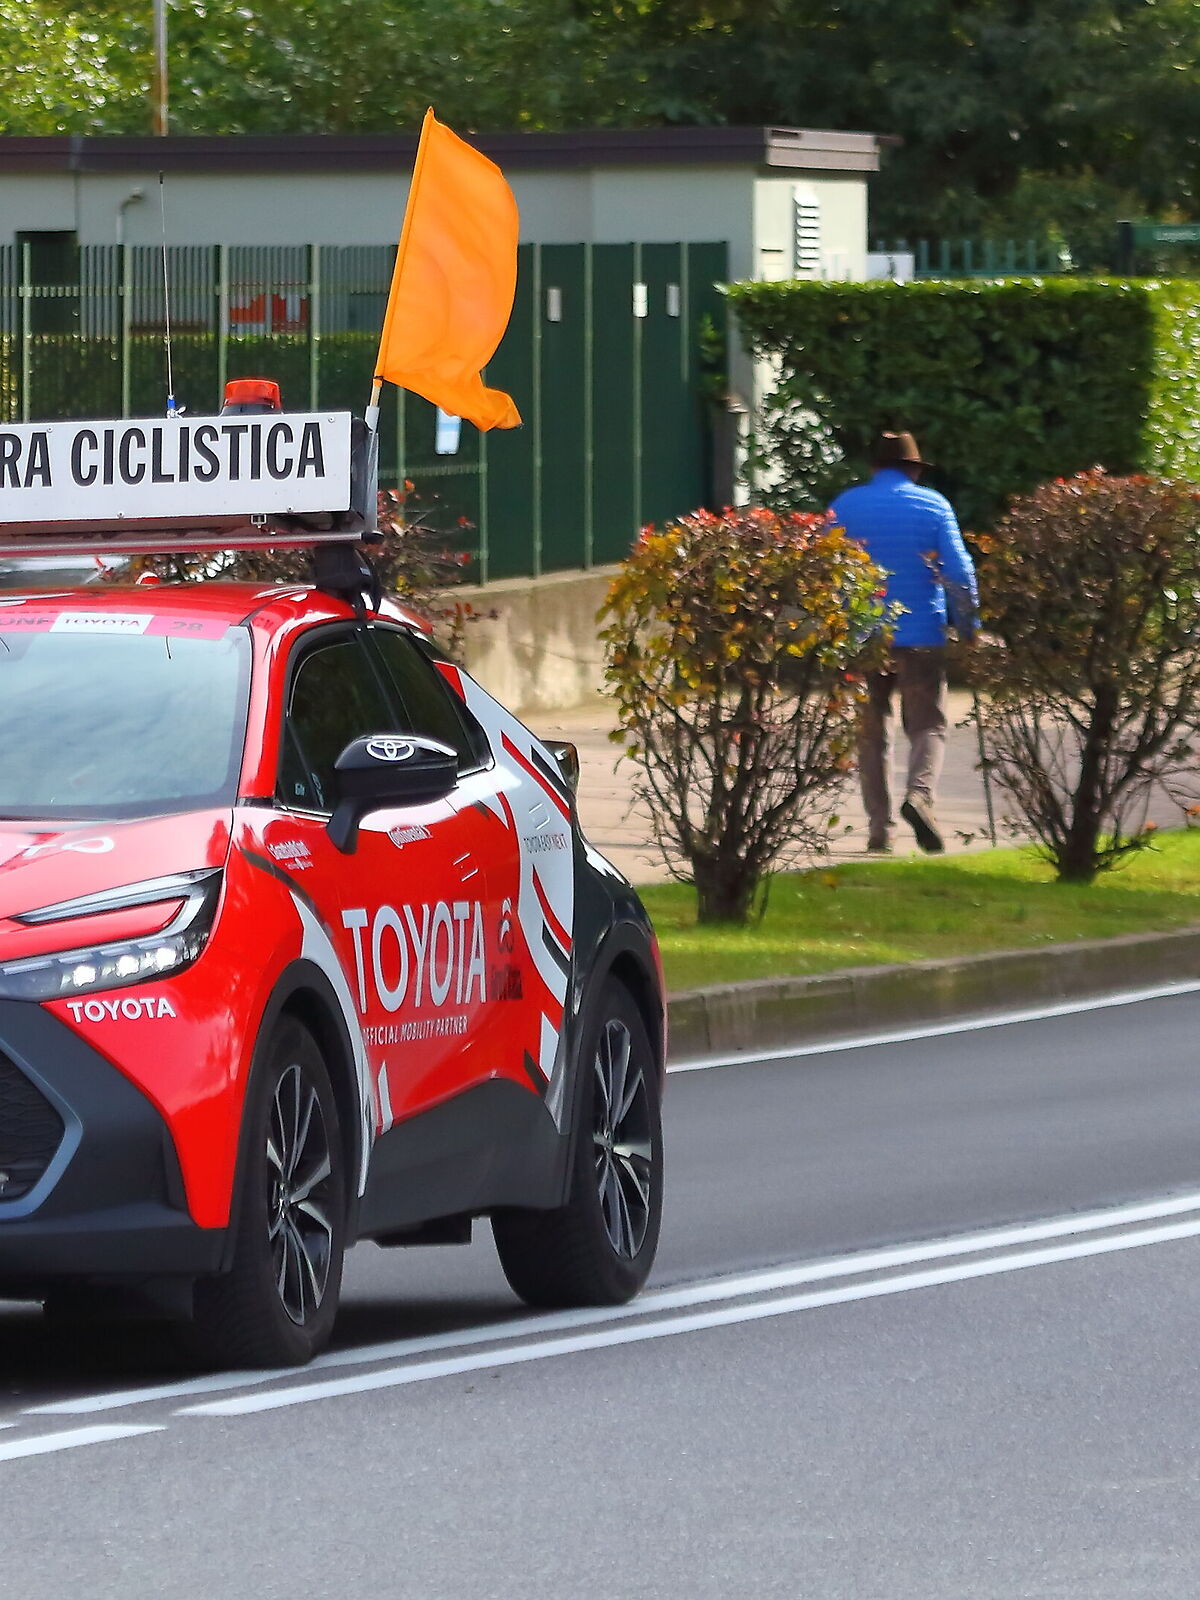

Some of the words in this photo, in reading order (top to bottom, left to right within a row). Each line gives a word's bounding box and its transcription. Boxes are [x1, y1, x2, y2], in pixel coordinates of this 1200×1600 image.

[70, 421, 326, 487] CICLISTICA
[64, 617, 141, 627] TOYOTA
[341, 900, 487, 1014] TOYOTA
[66, 997, 177, 1023] TOYOTA
[401, 1020, 435, 1042] MOBILITY
[436, 1015, 469, 1037] PARTNER
